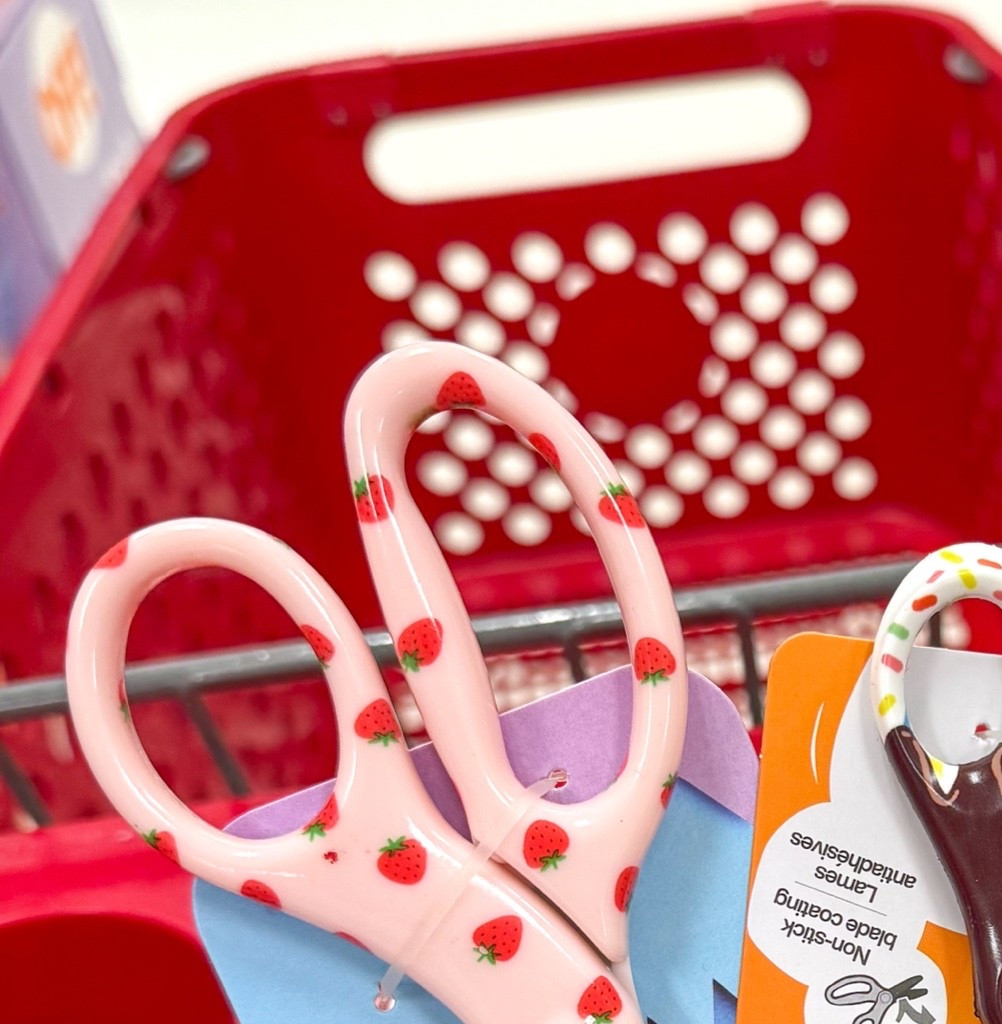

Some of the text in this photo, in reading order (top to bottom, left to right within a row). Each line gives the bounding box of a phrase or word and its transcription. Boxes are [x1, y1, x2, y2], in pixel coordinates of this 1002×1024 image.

[790, 831, 917, 888] antiadhésives
[815, 866, 878, 903] Lames
[773, 888, 897, 951] blade coating
[781, 918, 871, 966] Non-stick
